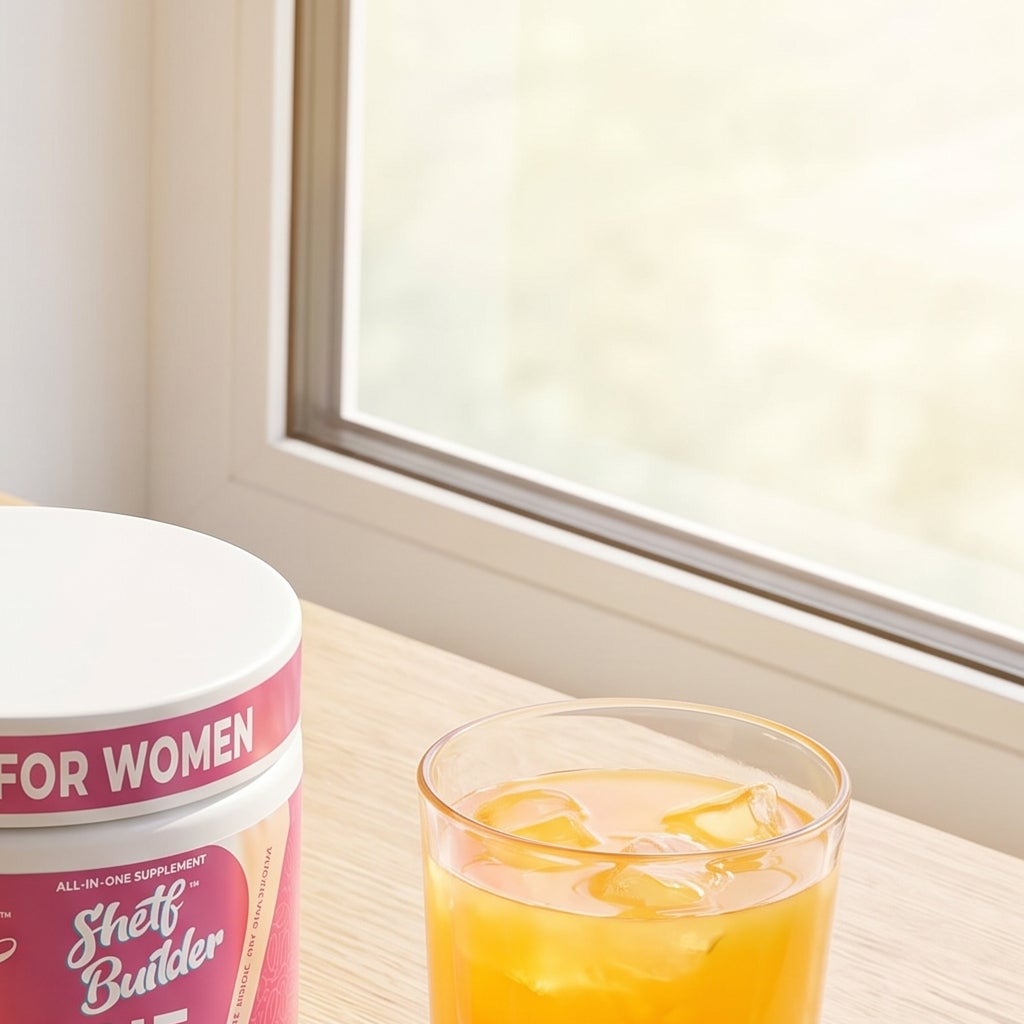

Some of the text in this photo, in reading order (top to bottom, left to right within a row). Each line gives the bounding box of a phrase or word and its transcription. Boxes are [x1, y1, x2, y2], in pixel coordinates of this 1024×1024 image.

[103, 706, 255, 793] WOMEN
[56, 854, 207, 893] ALL-IN-ONE SUPPLEMENT
